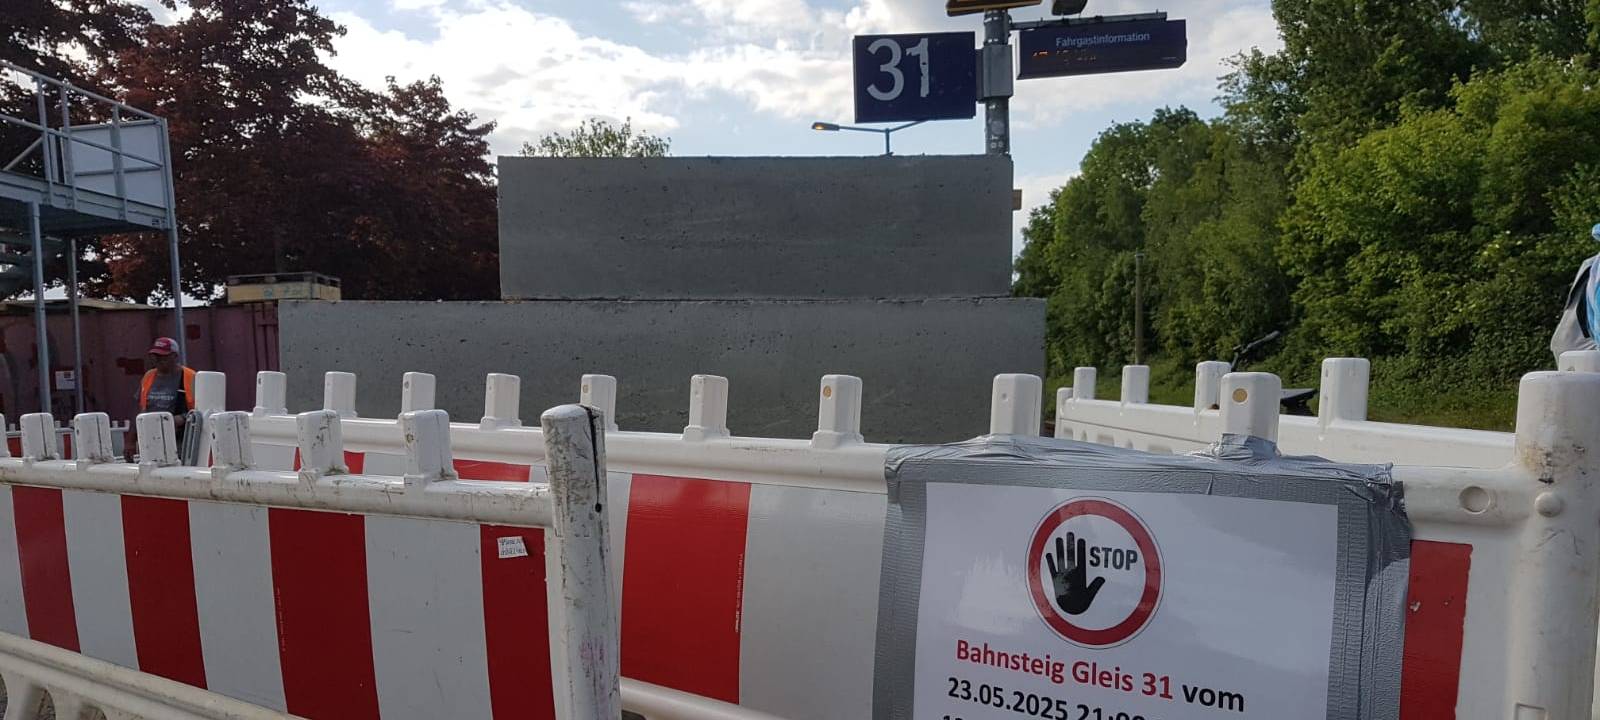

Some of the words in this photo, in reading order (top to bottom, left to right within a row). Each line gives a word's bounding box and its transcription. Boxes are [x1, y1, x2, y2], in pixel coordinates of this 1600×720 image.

[1056, 32, 1150, 48] Fahrgastinformation
[867, 38, 930, 101] 31
[1089, 546, 1138, 571] STOP
[956, 640, 1065, 684] Bahnsteig
[1072, 660, 1133, 692] Gleis
[1141, 672, 1173, 700] 31
[1182, 684, 1245, 712] vom
[948, 677, 1068, 720] 23.05.2025
